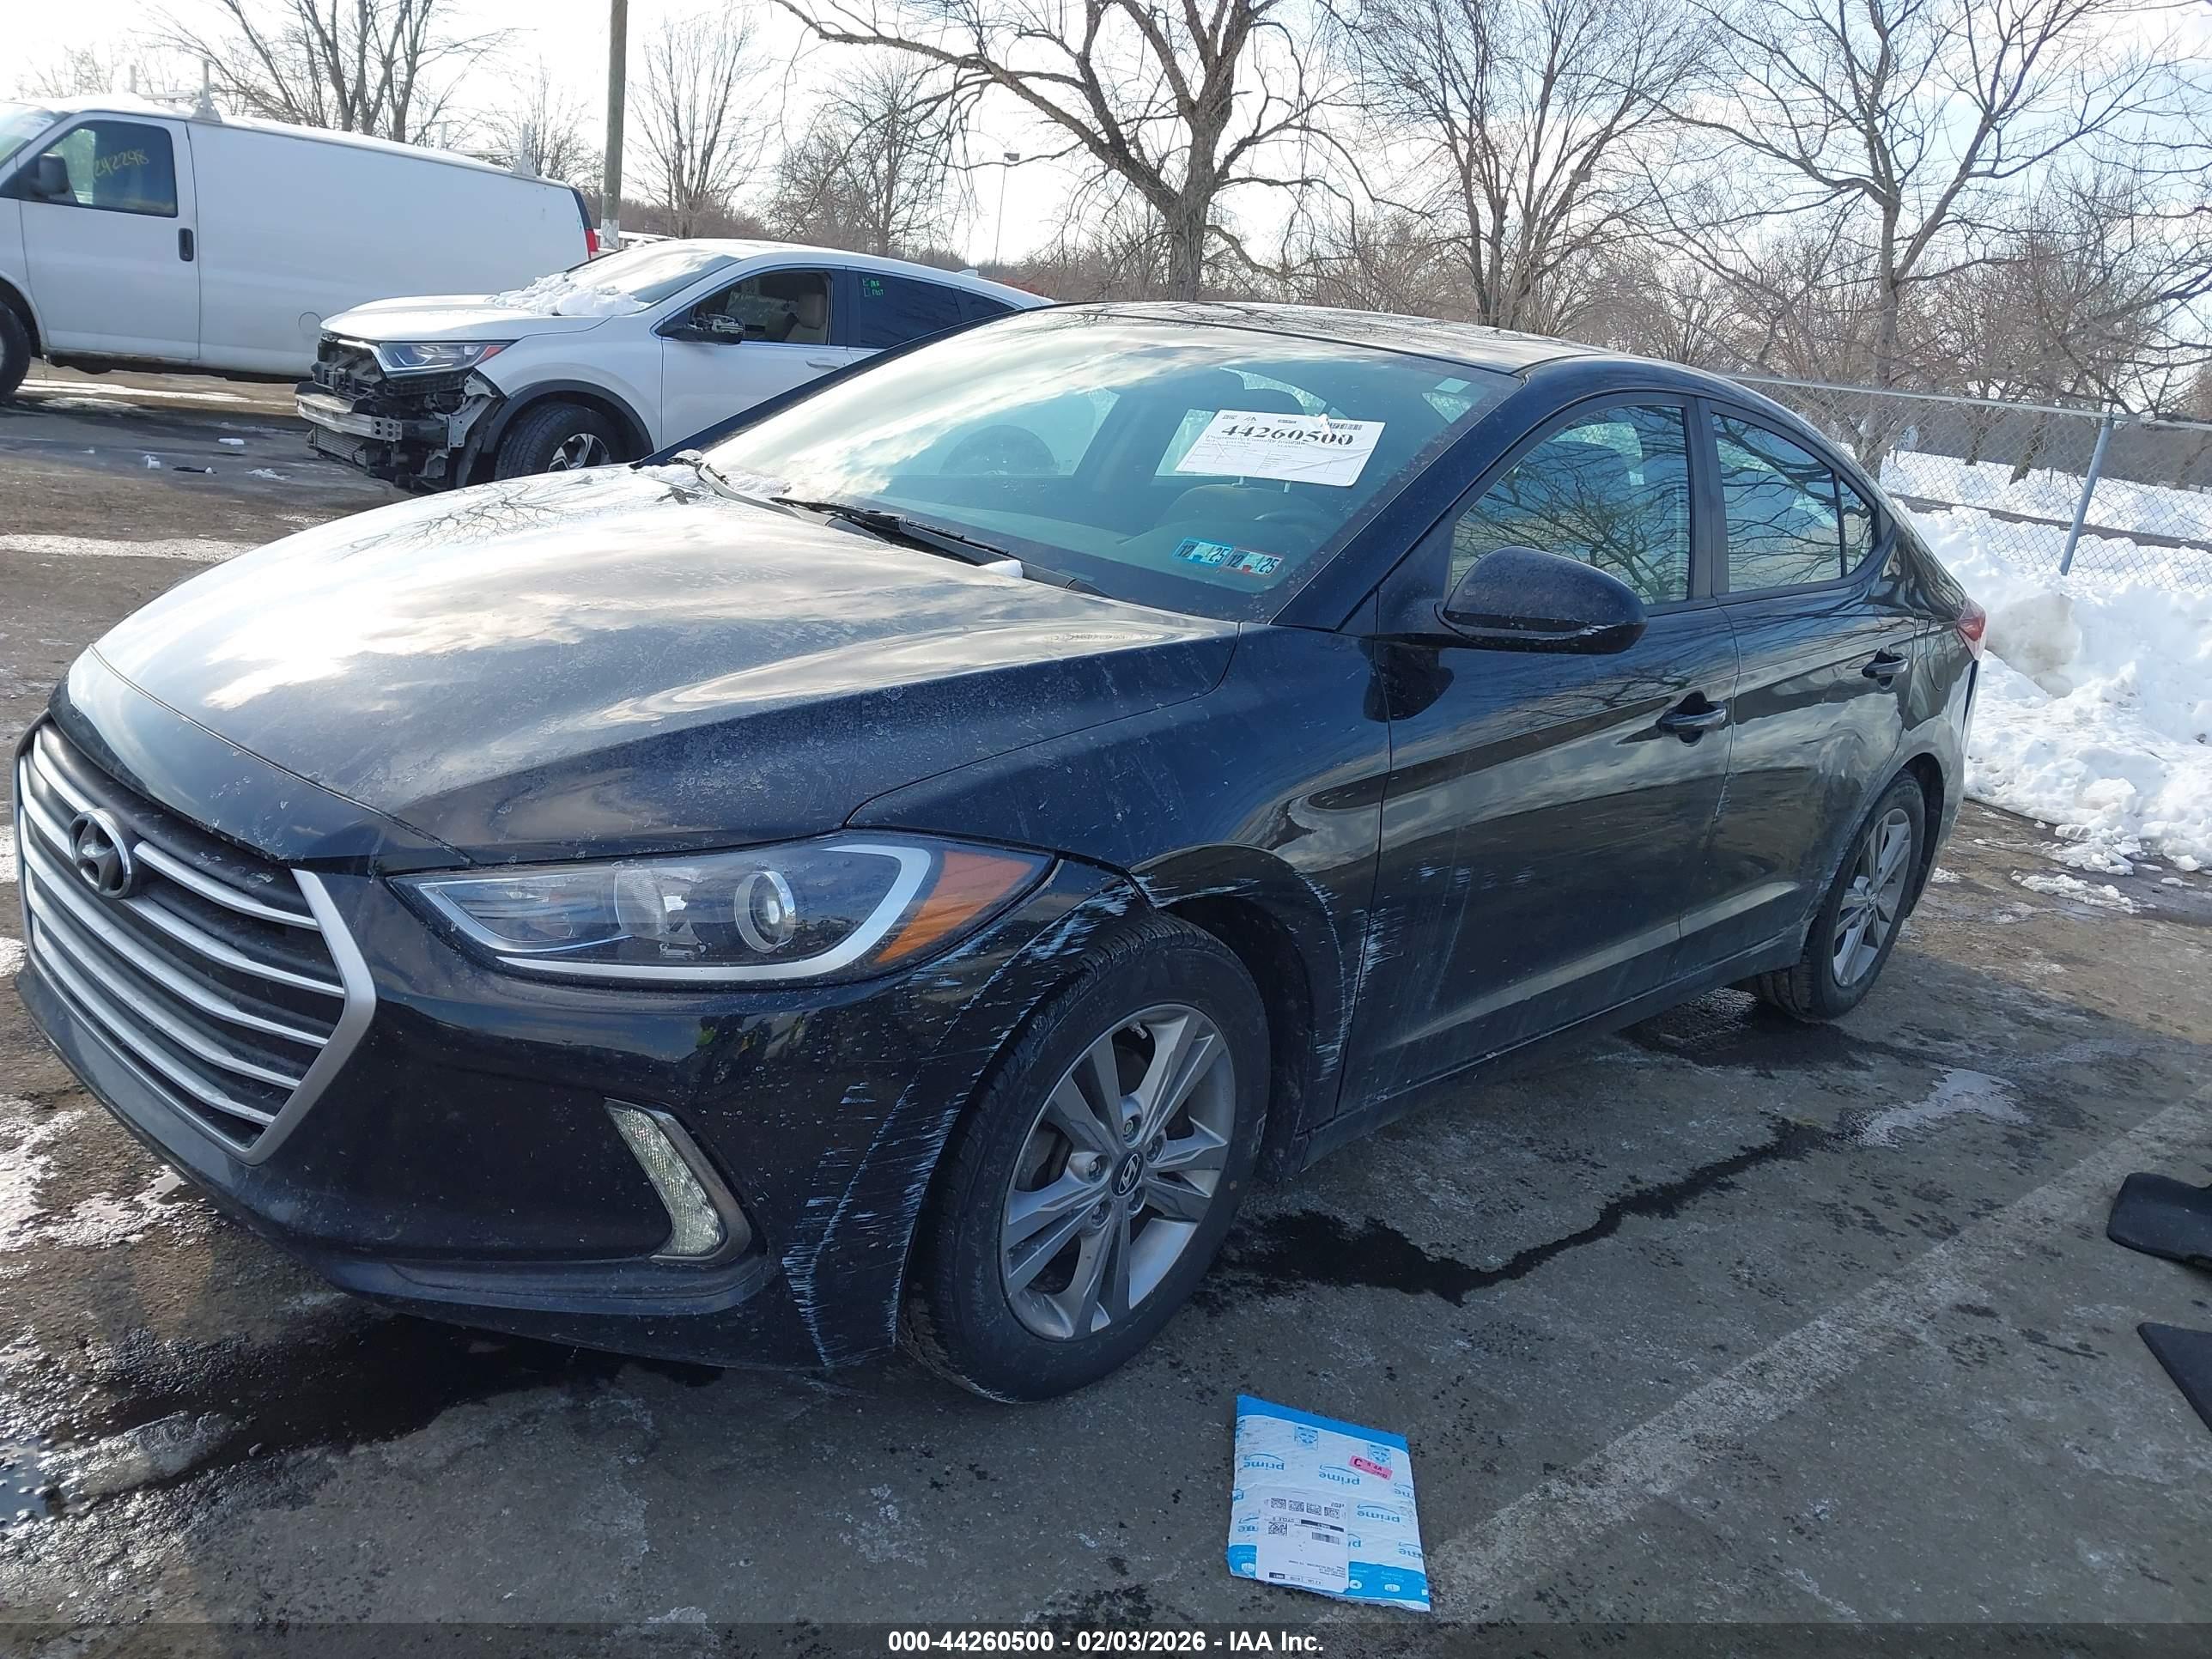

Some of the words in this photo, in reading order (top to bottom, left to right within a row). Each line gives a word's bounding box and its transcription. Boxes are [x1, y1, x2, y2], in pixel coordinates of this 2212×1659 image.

[1221, 424, 1354, 446] 44260500
[1259, 557, 1279, 574] 25
[1243, 1462, 1285, 1471] prime
[1319, 1471, 1360, 1486] prime
[1357, 1510, 1401, 1523] prime
